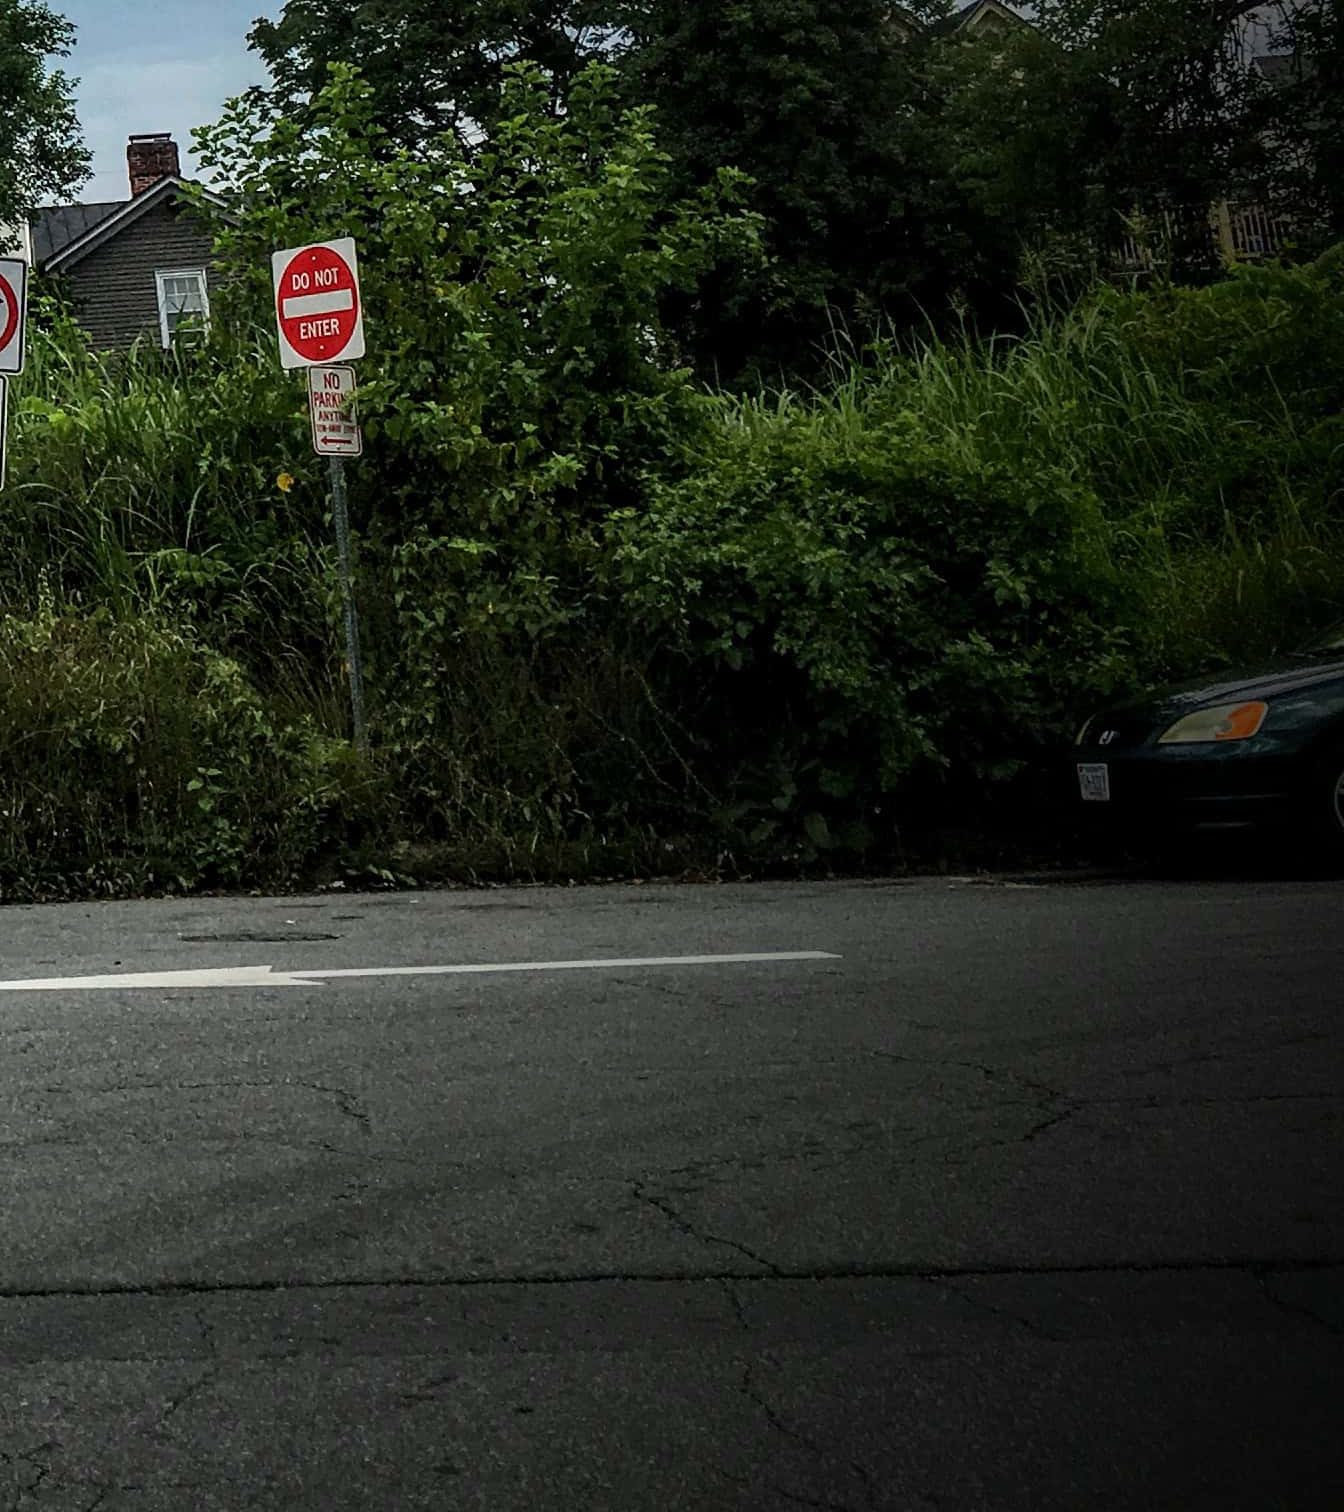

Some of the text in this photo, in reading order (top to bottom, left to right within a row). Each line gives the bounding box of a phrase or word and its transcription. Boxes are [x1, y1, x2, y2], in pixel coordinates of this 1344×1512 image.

[292, 268, 338, 290] DO NOT
[300, 319, 340, 339] ENTER
[323, 373, 339, 390] NO
[314, 392, 349, 409] PARKI
